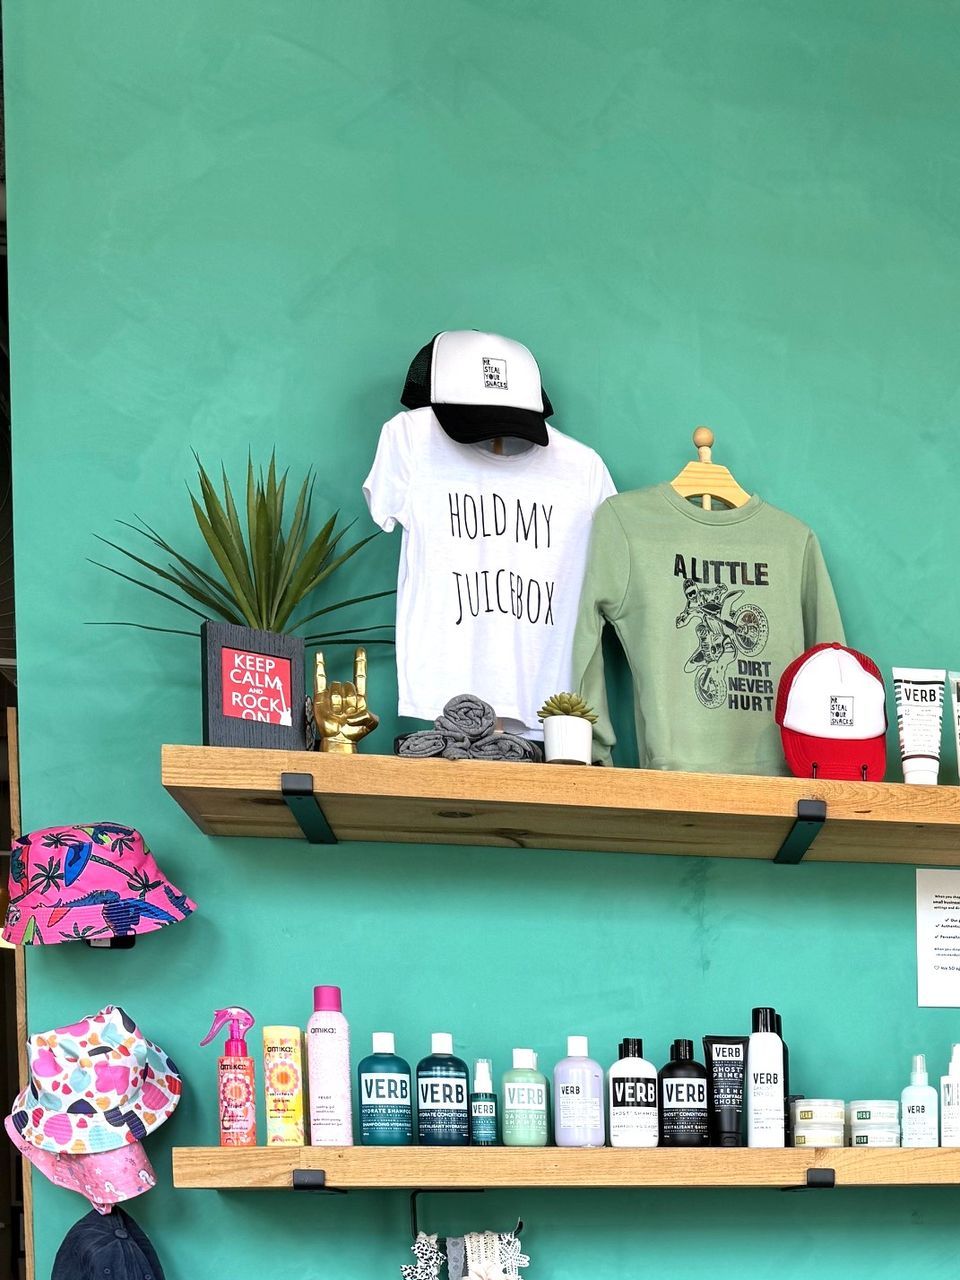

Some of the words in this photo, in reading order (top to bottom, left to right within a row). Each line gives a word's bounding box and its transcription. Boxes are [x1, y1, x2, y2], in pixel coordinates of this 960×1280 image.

[484, 366, 501, 375] STEAL
[484, 373, 500, 381] YOUR
[448, 492, 507, 540] HOLD
[515, 498, 553, 550] MY
[673, 553, 689, 580] A
[690, 556, 770, 587] LITTLE
[451, 568, 555, 627] JUICEBOX
[234, 653, 276, 673] KEEP
[737, 659, 772, 678] DIRT
[229, 669, 282, 690] CALM
[728, 677, 774, 694] NEVER
[248, 687, 263, 695] AND
[904, 687, 937, 703] VERB
[231, 691, 281, 713] ROCK
[728, 694, 774, 712] HURT
[831, 704, 848, 712] STEAL
[241, 708, 271, 723] ON
[715, 1047, 741, 1058] VERB
[365, 1078, 408, 1098] VERB
[753, 1073, 779, 1085] VERB
[420, 1083, 464, 1103] VERB
[507, 1087, 544, 1105] VERB
[561, 1085, 581, 1095] VERB
[615, 1082, 656, 1102] VERB
[666, 1083, 705, 1103] VERB
[473, 1104, 494, 1114] VERB
[907, 1105, 926, 1114] VERB
